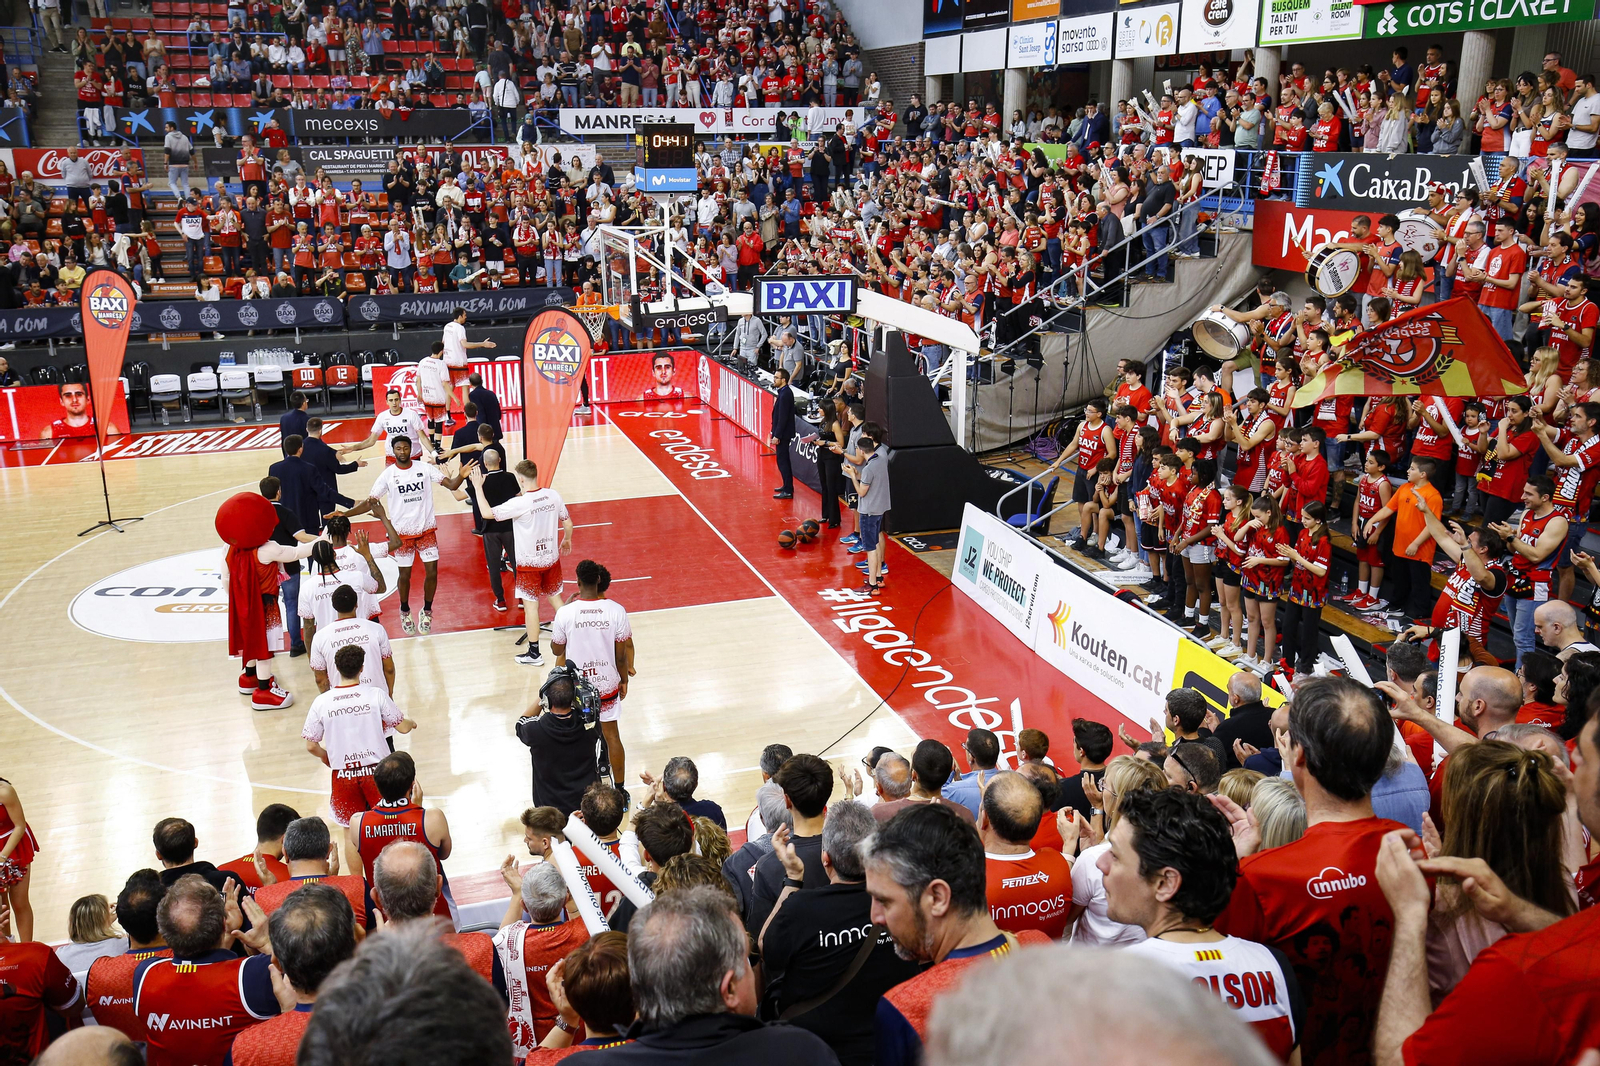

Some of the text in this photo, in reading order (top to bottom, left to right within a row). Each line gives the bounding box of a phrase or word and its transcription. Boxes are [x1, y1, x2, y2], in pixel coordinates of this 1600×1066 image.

[1271, 0, 1310, 12] BUSQUEM
[1331, 3, 1353, 11] TALENT
[1208, 8, 1228, 20] crem
[1271, 12, 1298, 24] TALENT
[1331, 11, 1351, 19] ROOM
[1407, 4, 1463, 28] COTS
[1270, 25, 1298, 36] PER TU!
[1061, 40, 1084, 53] sarsa
[1119, 39, 1135, 48] SPORT
[305, 118, 379, 134] mecexis
[742, 115, 763, 127] Cor
[653, 134, 687, 147] 04:41
[309, 151, 334, 161] CAL
[336, 149, 394, 160] SPAGUETTI
[766, 282, 847, 310] BAXI
[90, 297, 128, 311] BAXI
[97, 312, 123, 320] MANRESA
[654, 311, 718, 329] endesa
[533, 344, 581, 362] BAXI
[300, 370, 314, 379] 00
[337, 368, 348, 379] 12
[543, 363, 574, 374] MANRESA
[619, 410, 688, 419] acb
[387, 425, 408, 433] BAXI
[112, 428, 256, 457] ESTRELLA
[649, 429, 732, 480] endesa
[398, 481, 425, 493] BAXI
[530, 504, 555, 515] inmoovs
[986, 539, 1013, 566] YOU SHIP
[982, 559, 1026, 605] WE PROTECT
[575, 620, 610, 629] inmoovs
[331, 635, 369, 648] inmoovs
[1071, 621, 1162, 696] Kouten.cat
[583, 669, 598, 677] ETL
[1069, 647, 1125, 688] Una xarxa de solucions
[328, 703, 371, 718] inmoovs
[344, 750, 375, 762] Adbisio
[365, 822, 417, 838] R.MARTÍNEZ
[1002, 874, 1039, 889] PENTEX
[1313, 873, 1367, 894] innubo
[991, 894, 1065, 920] inmoovs
[1046, 908, 1065, 919] AVINENT
[169, 1015, 233, 1030] AVINENT
